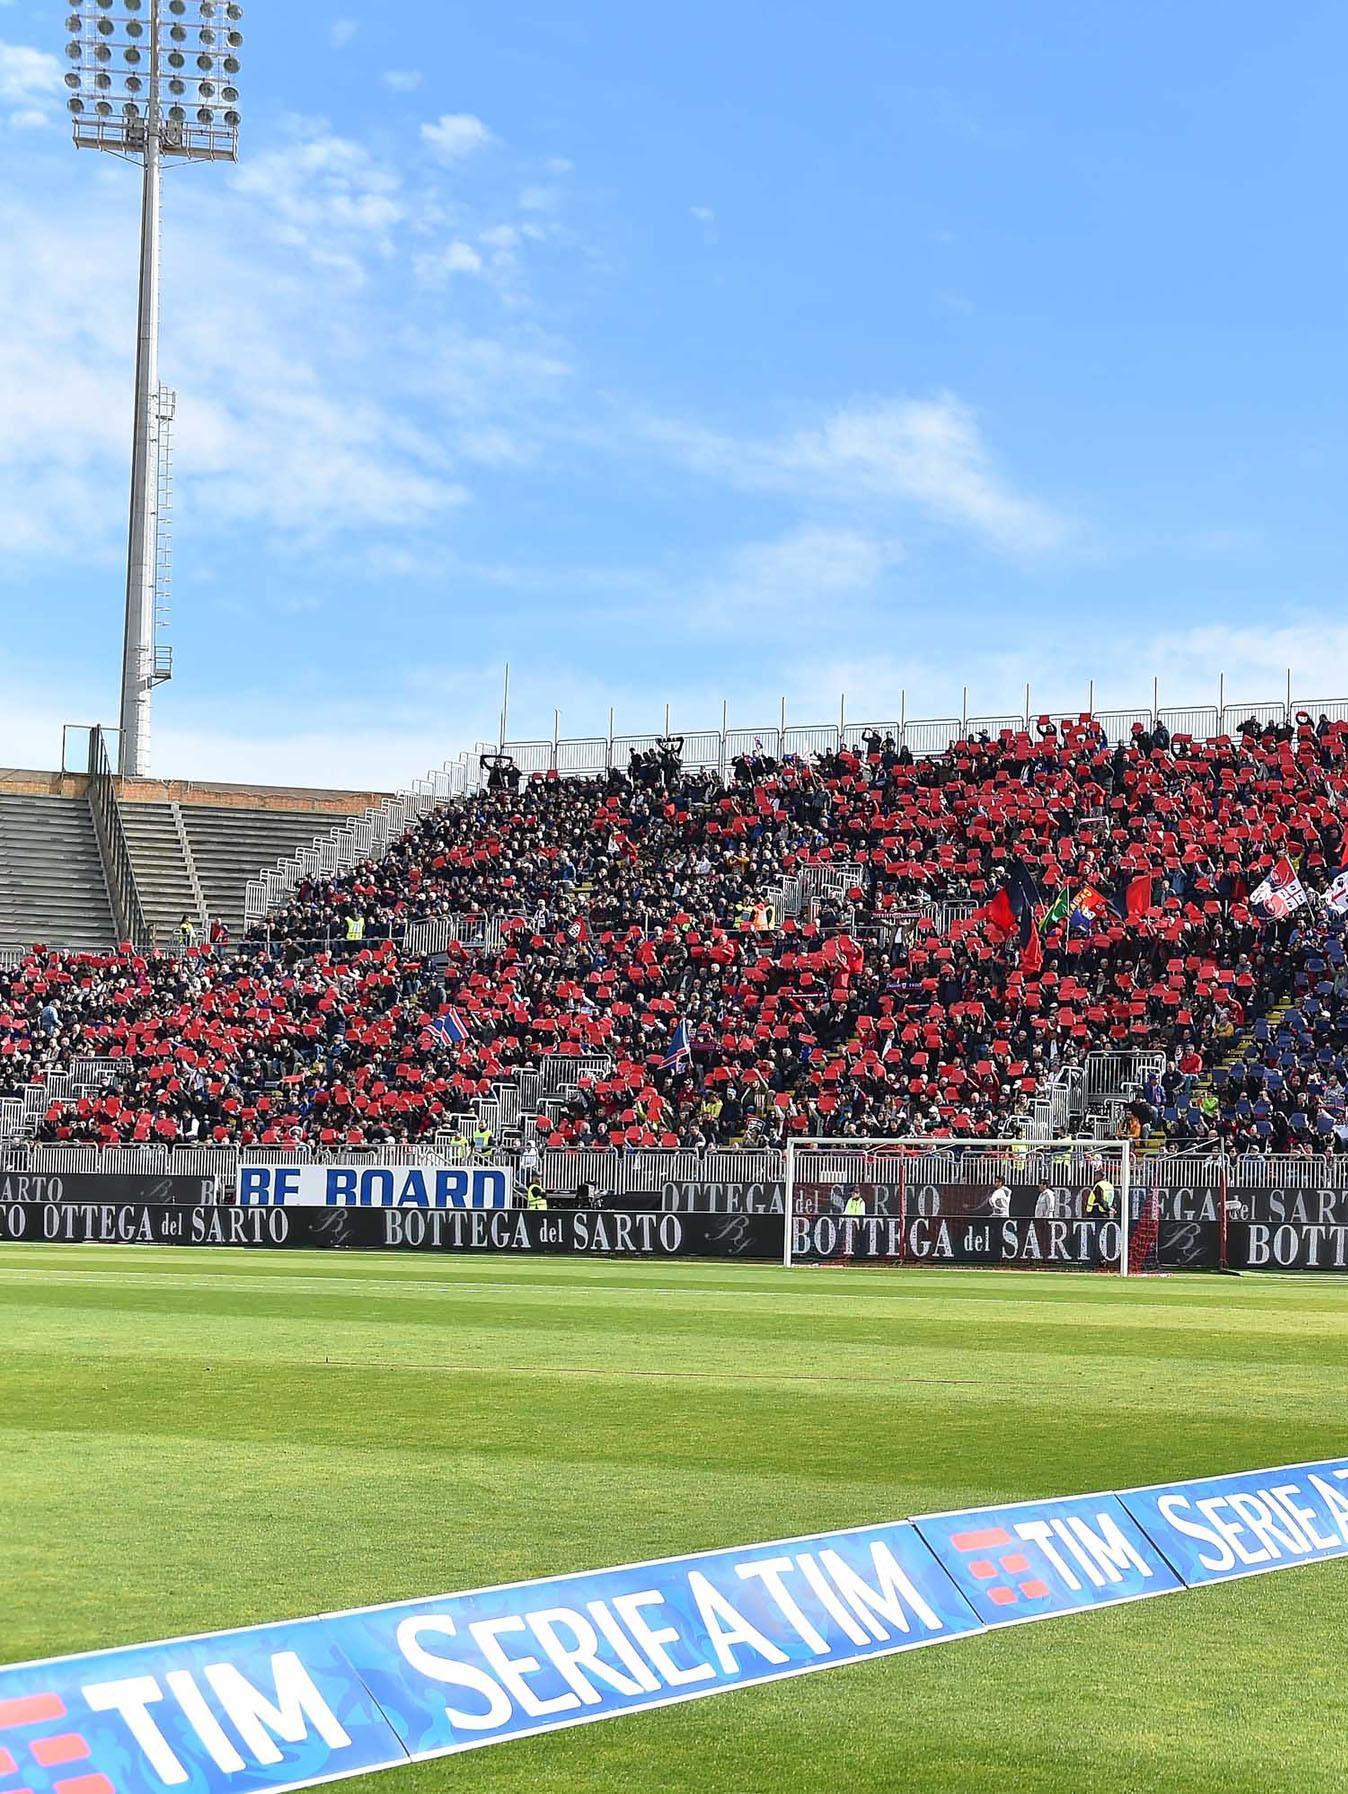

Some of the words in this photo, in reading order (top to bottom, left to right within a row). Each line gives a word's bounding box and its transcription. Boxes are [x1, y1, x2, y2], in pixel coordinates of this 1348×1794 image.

[795, 1190, 818, 1214] del
[831, 1184, 940, 1216] SRTO
[161, 1212, 183, 1236] del
[192, 1206, 289, 1244] SARTO
[384, 1209, 531, 1249] BOTTEGA
[539, 1218, 563, 1243] del
[573, 1213, 682, 1252] SARTO
[792, 1215, 954, 1258] BOTTEGA
[963, 1225, 990, 1252] del
[1001, 1219, 1121, 1262] SARTO
[1013, 1514, 1153, 1591] TIM
[82, 1651, 352, 1785] TIM
